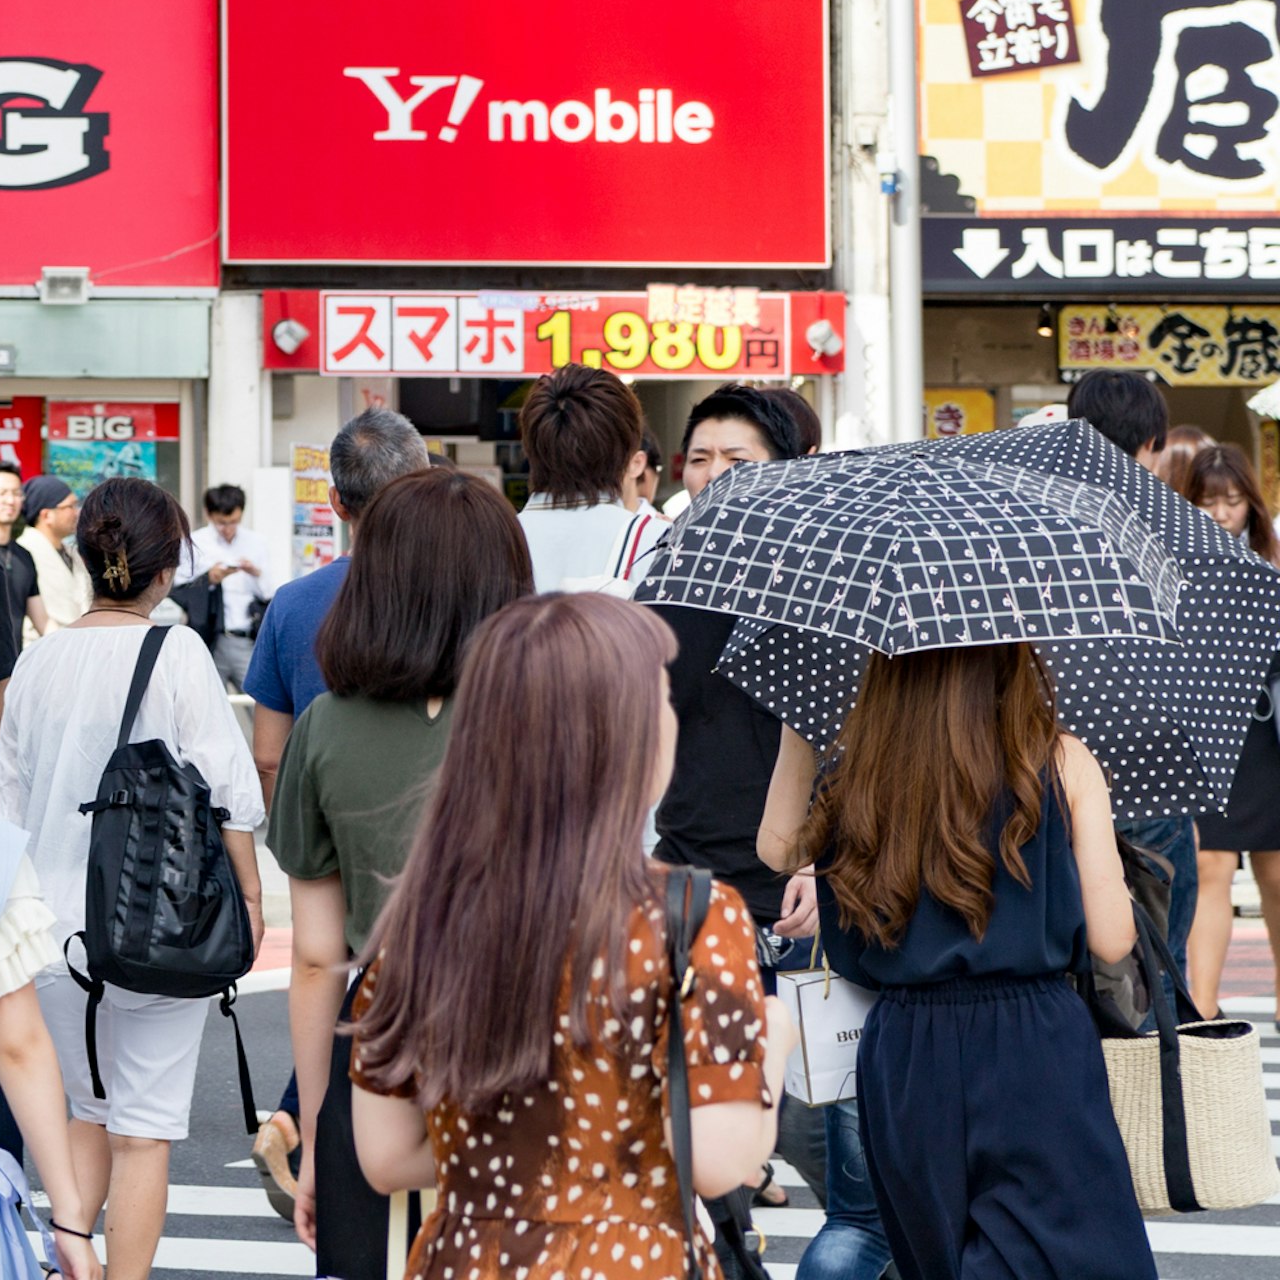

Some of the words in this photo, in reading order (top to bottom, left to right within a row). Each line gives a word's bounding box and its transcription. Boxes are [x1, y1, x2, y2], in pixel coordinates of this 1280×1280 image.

[332, 304, 517, 365] スマホ
[66, 413, 135, 441] BIG
